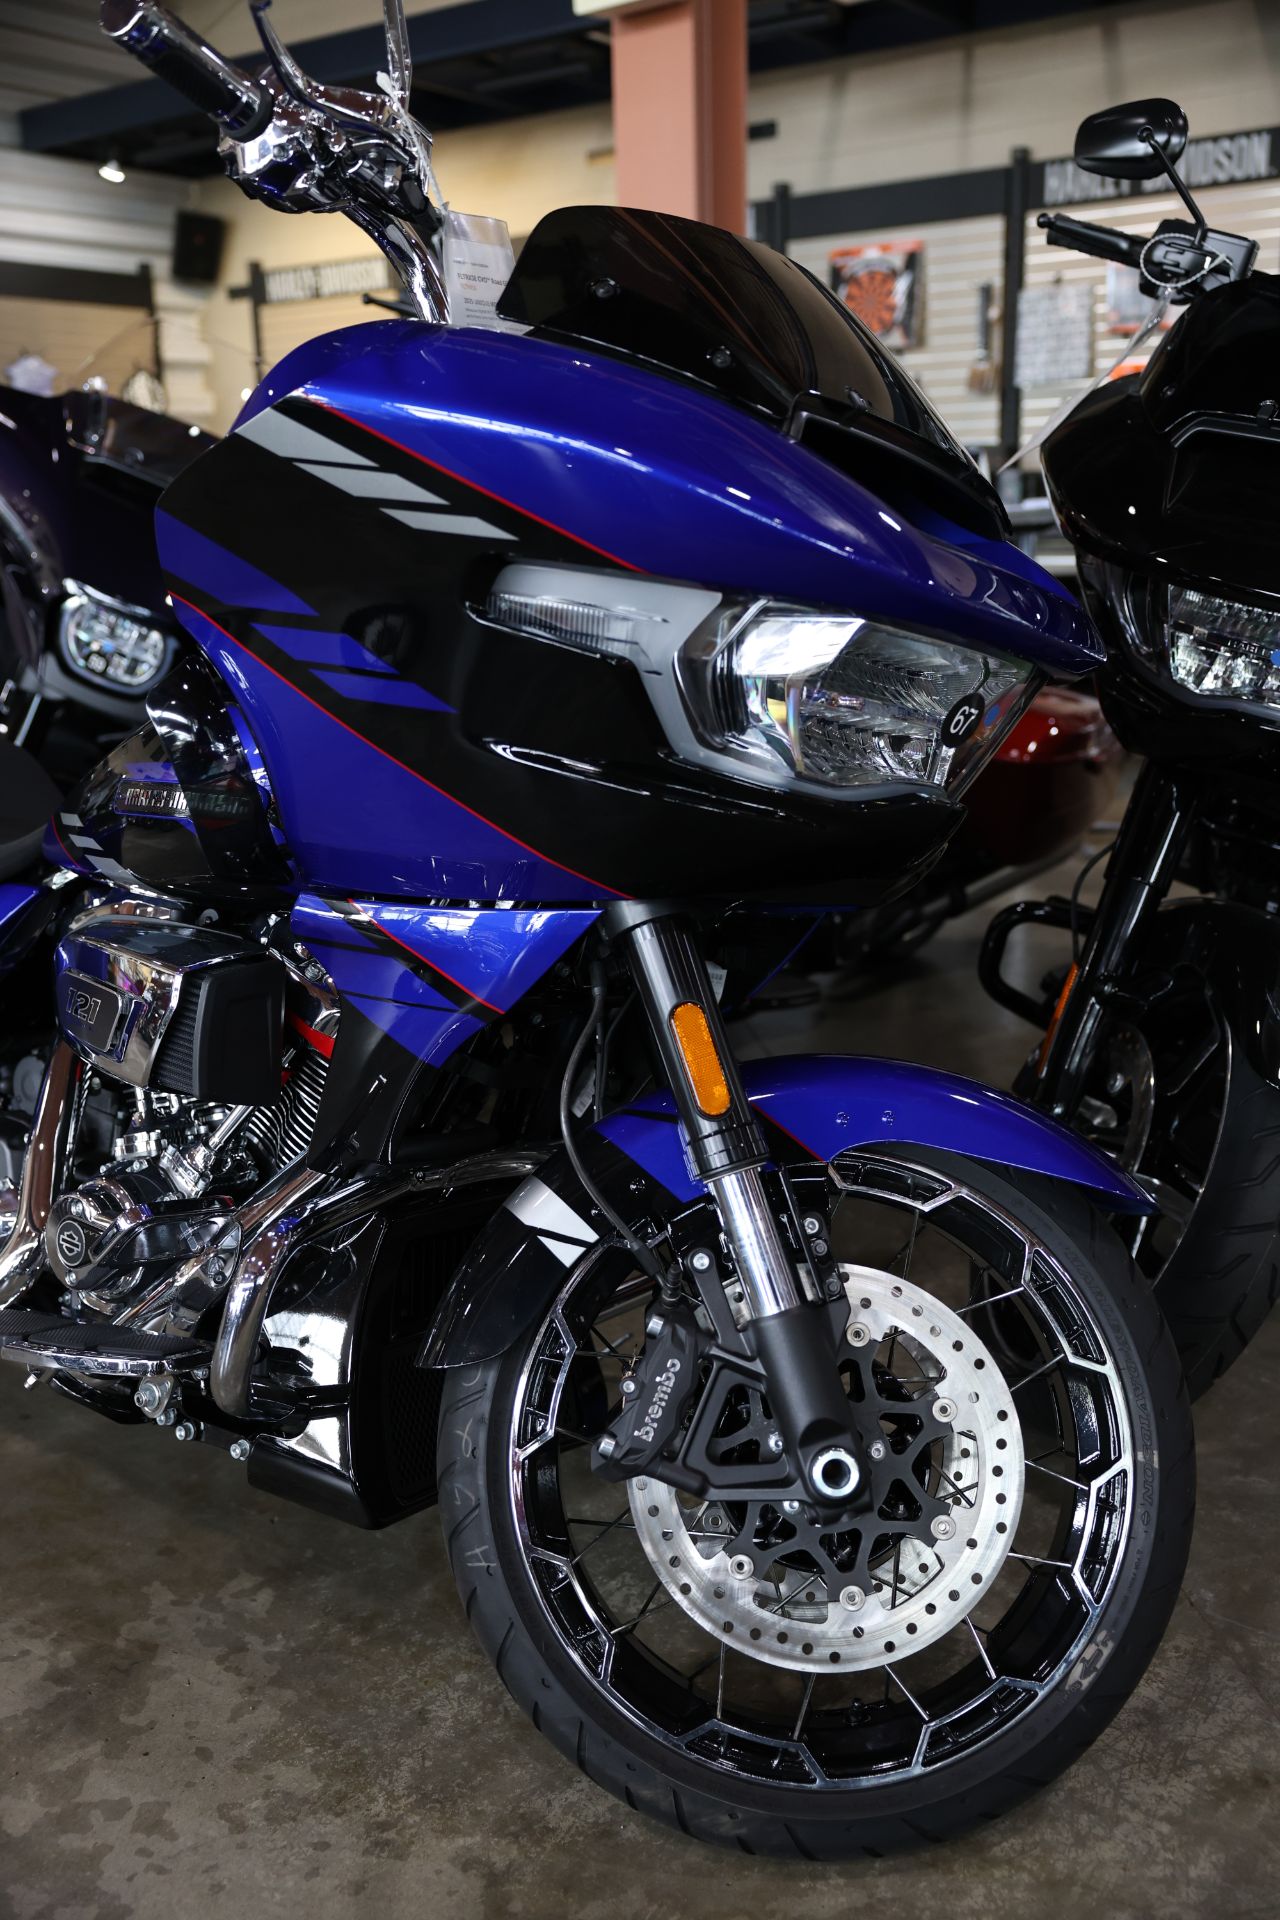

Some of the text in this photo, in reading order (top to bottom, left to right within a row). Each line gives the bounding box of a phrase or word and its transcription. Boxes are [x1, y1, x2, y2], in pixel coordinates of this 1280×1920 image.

[950, 705, 979, 736] 67
[66, 986, 102, 1025] 121
[633, 1358, 681, 1442] brembo
